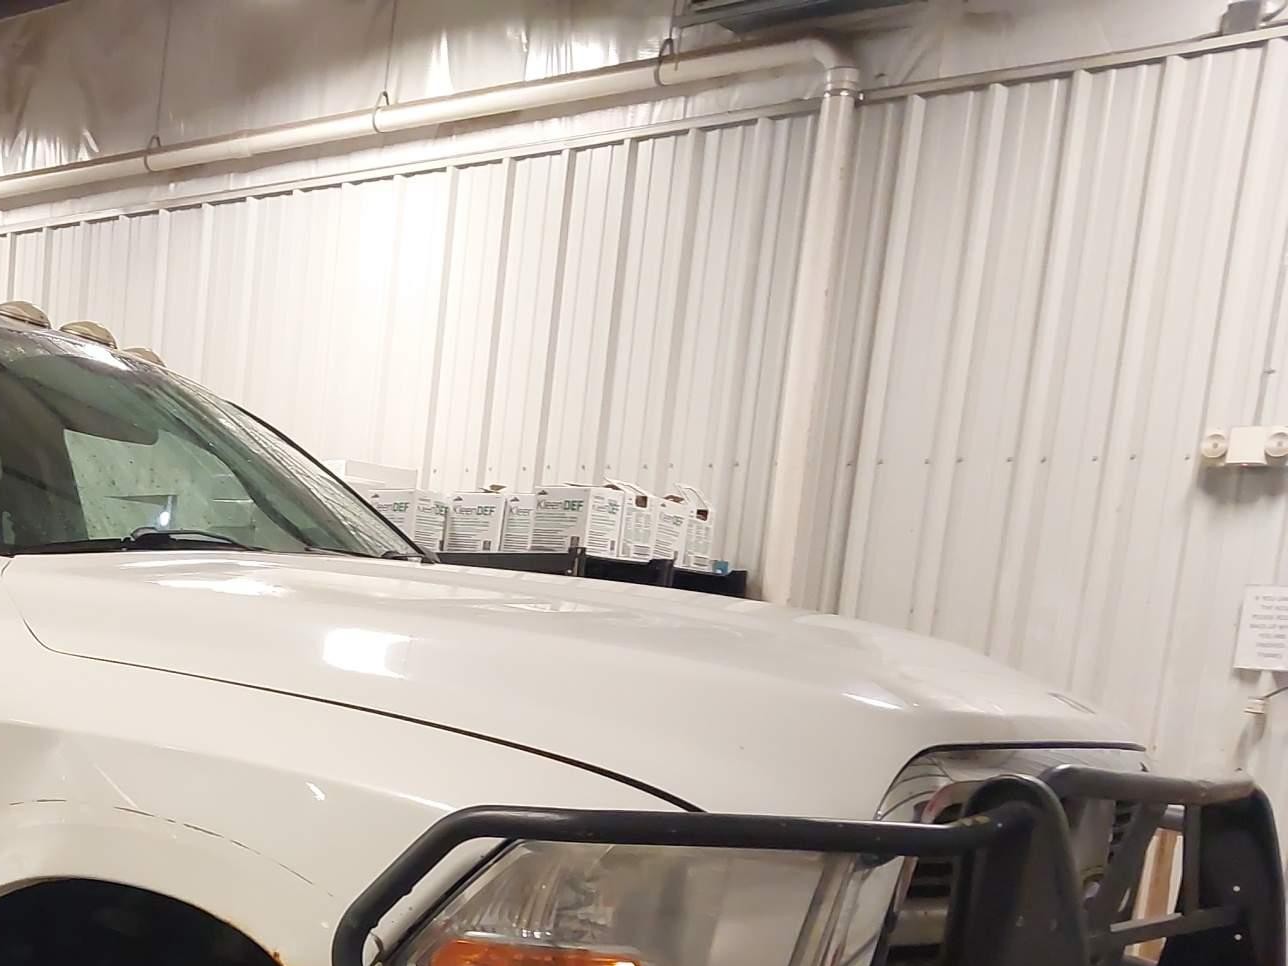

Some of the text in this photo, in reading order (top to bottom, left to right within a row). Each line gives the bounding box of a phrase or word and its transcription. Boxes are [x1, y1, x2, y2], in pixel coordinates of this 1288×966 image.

[375, 502, 410, 512] leenDEF
[509, 505, 533, 516] Kleen
[537, 500, 584, 511] KleenDEF
[453, 506, 495, 516] KleenDEF
